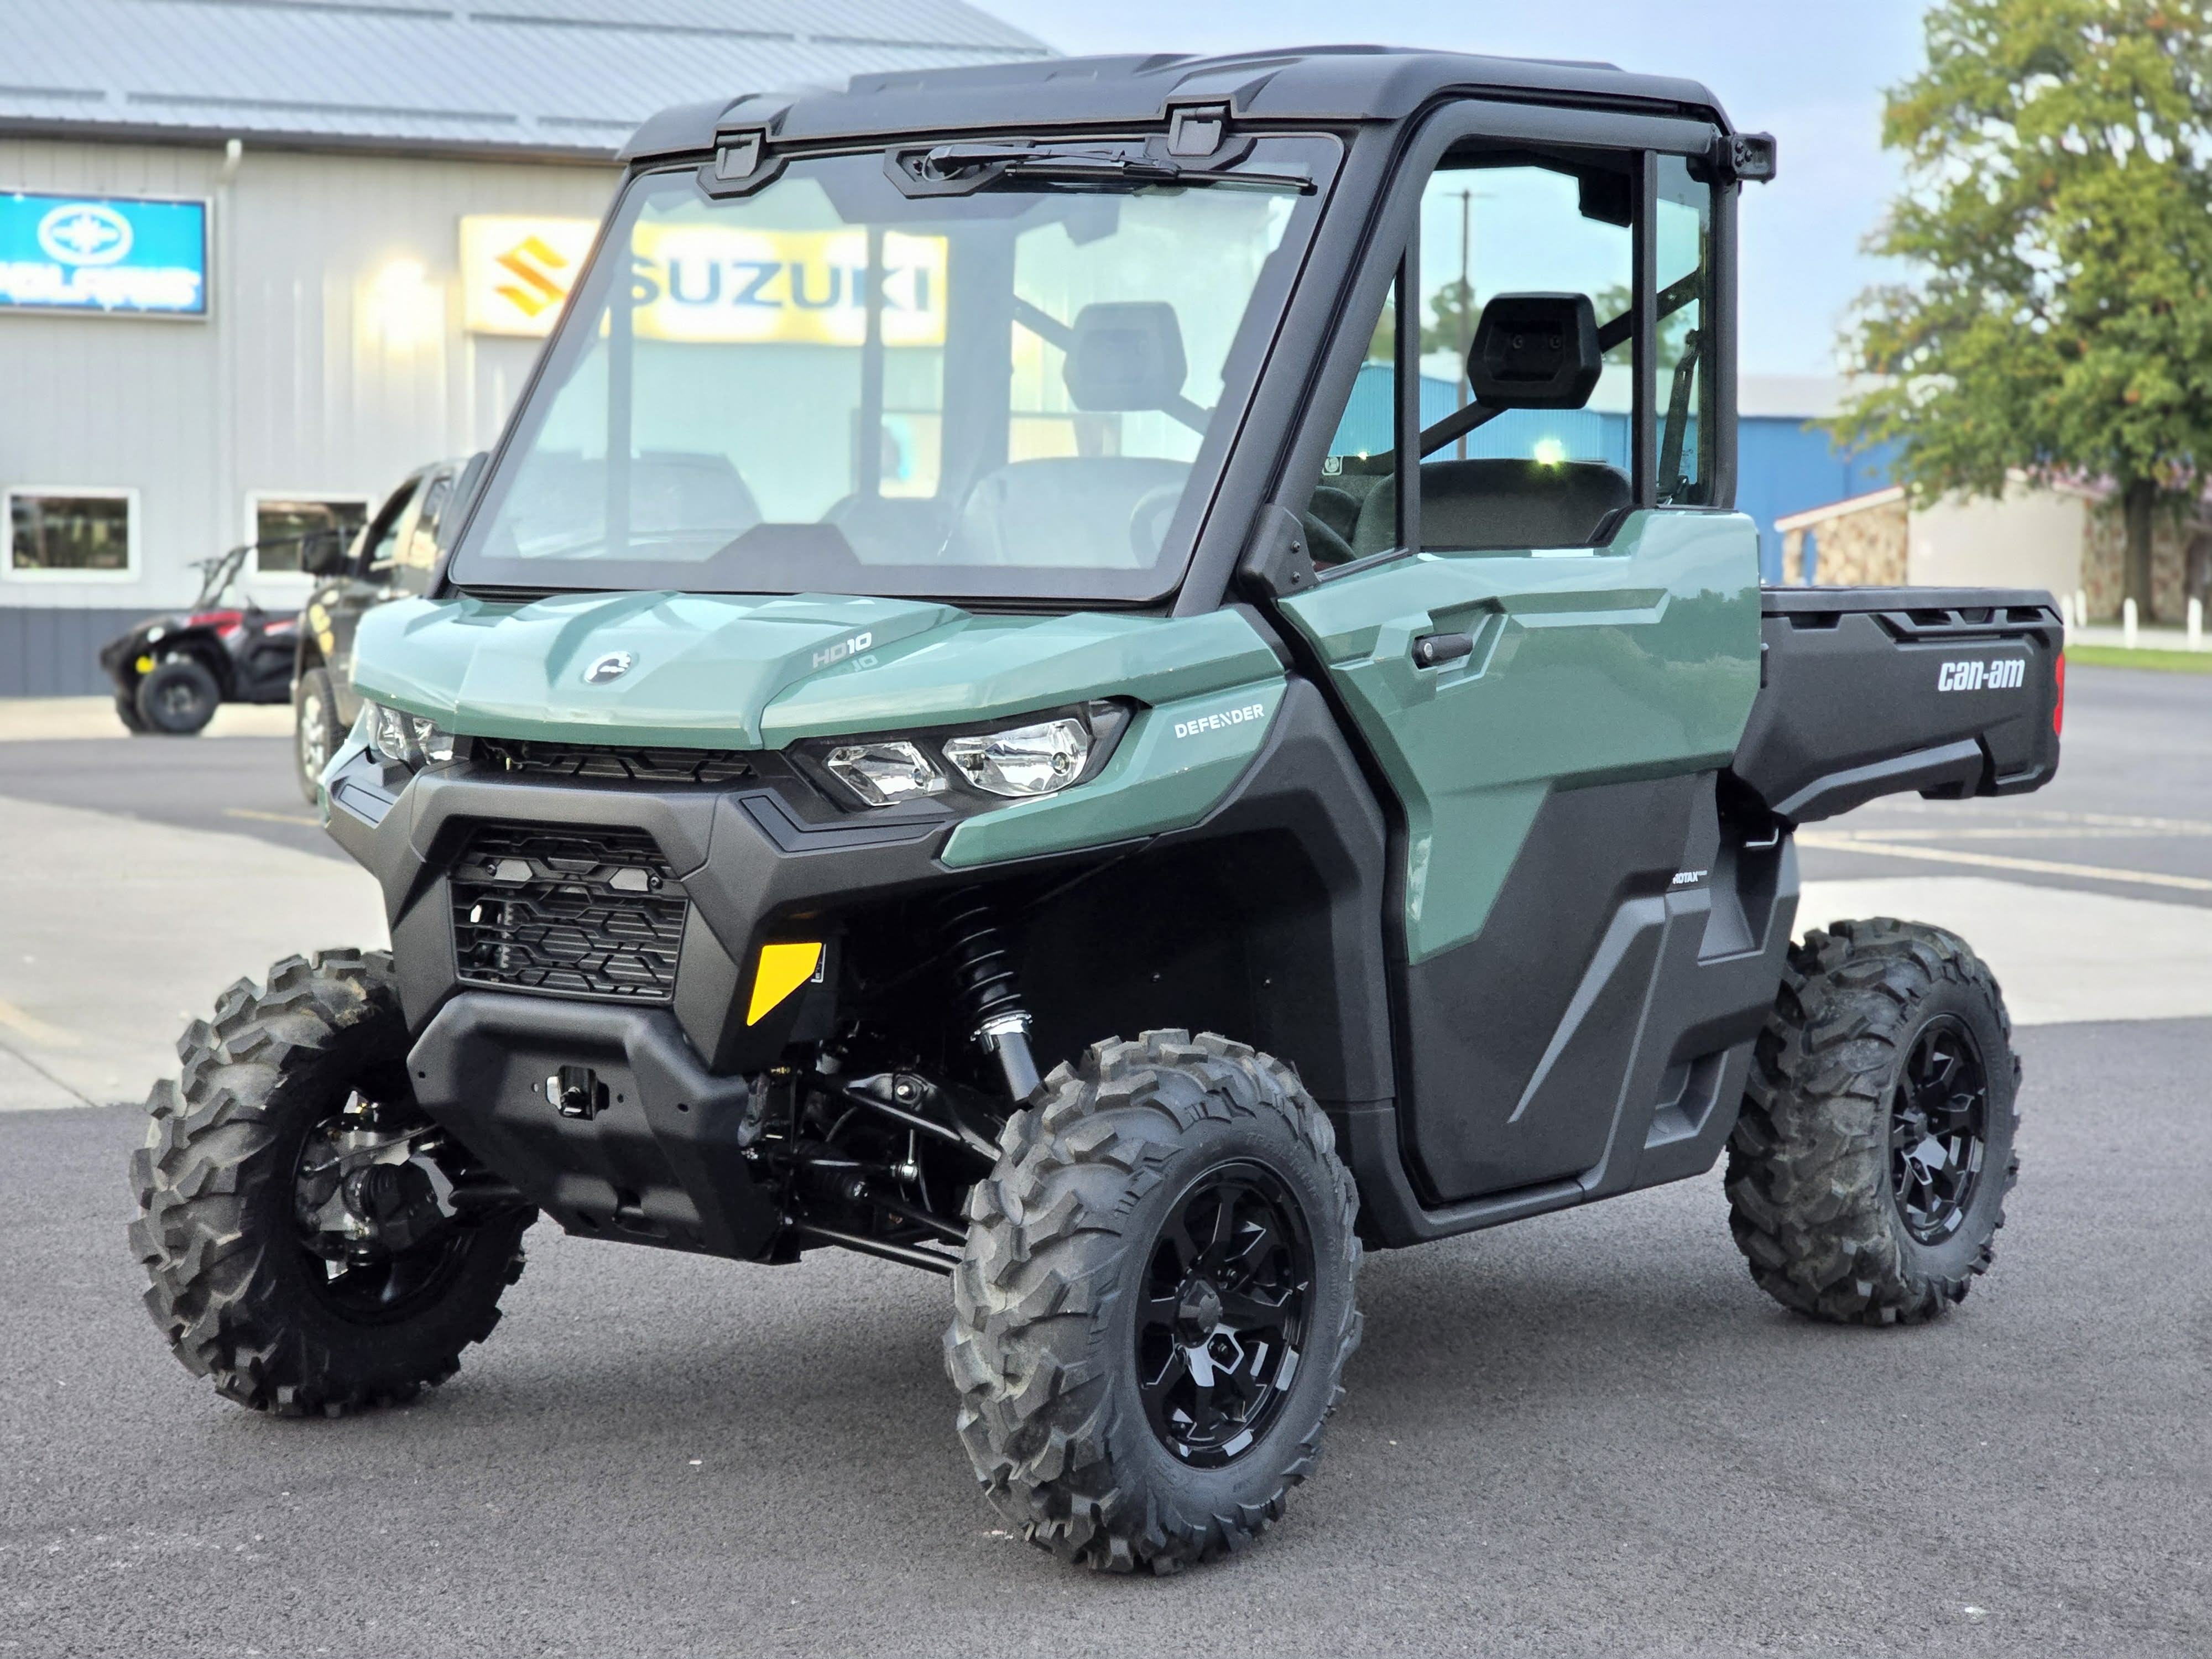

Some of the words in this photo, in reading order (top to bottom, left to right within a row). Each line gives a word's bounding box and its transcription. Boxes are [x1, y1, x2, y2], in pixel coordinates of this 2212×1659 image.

[629, 255, 929, 312] SUZUKI
[812, 632, 872, 669] HD10
[1938, 659, 2025, 691] can-am
[1174, 703, 1265, 739] DEFENDER
